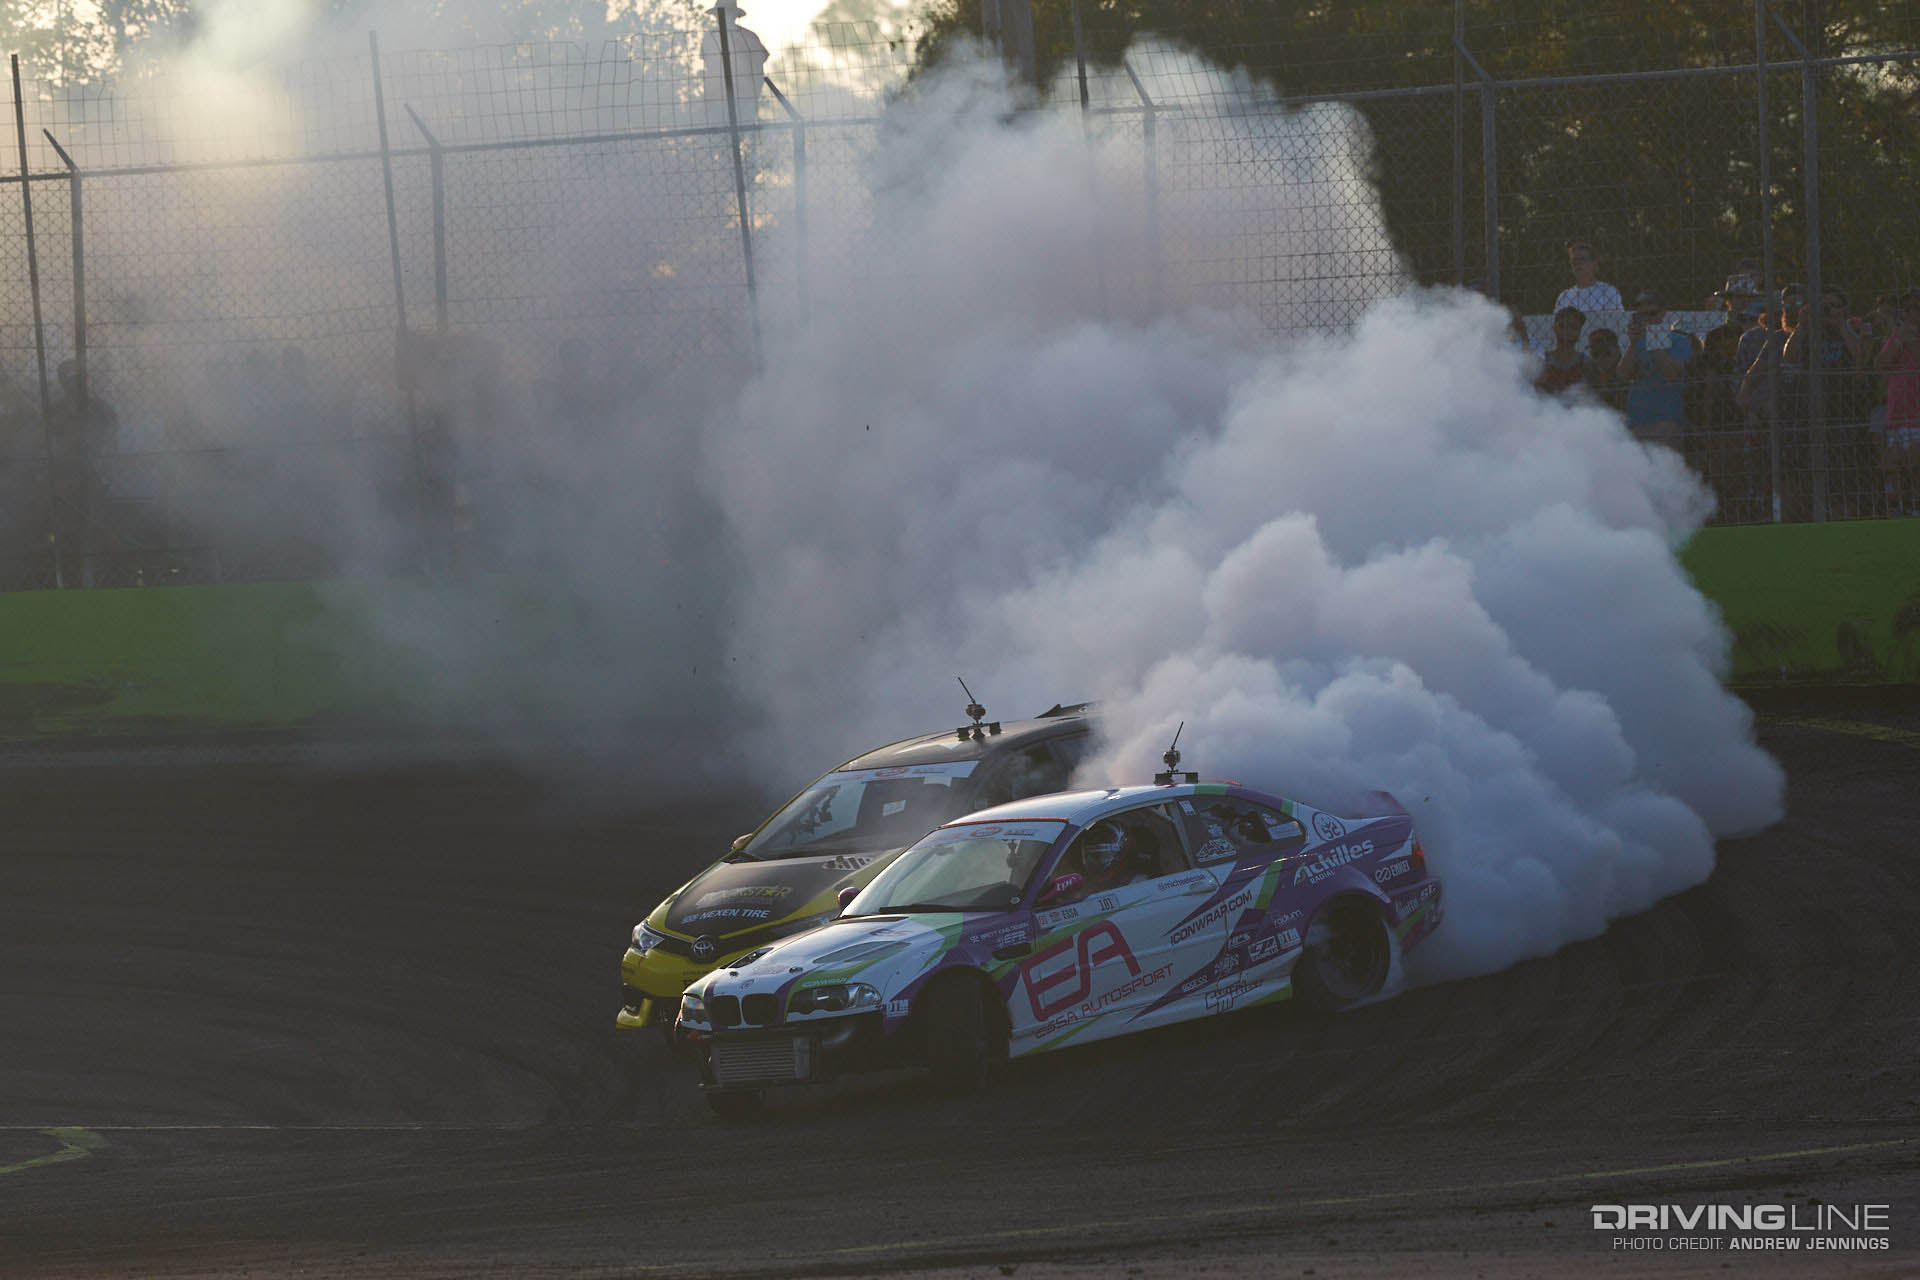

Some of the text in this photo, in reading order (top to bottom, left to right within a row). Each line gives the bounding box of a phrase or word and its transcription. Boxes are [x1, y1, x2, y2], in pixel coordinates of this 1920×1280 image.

[1293, 840, 1375, 887] Achilles
[1310, 869, 1336, 885] RADIAL
[699, 908, 772, 921] NEXEN TIRE
[1170, 889, 1253, 945] ICONWRAP.COM
[1035, 1010, 1078, 1039] ESSA
[1081, 962, 1174, 1018] AUTOSPORT
